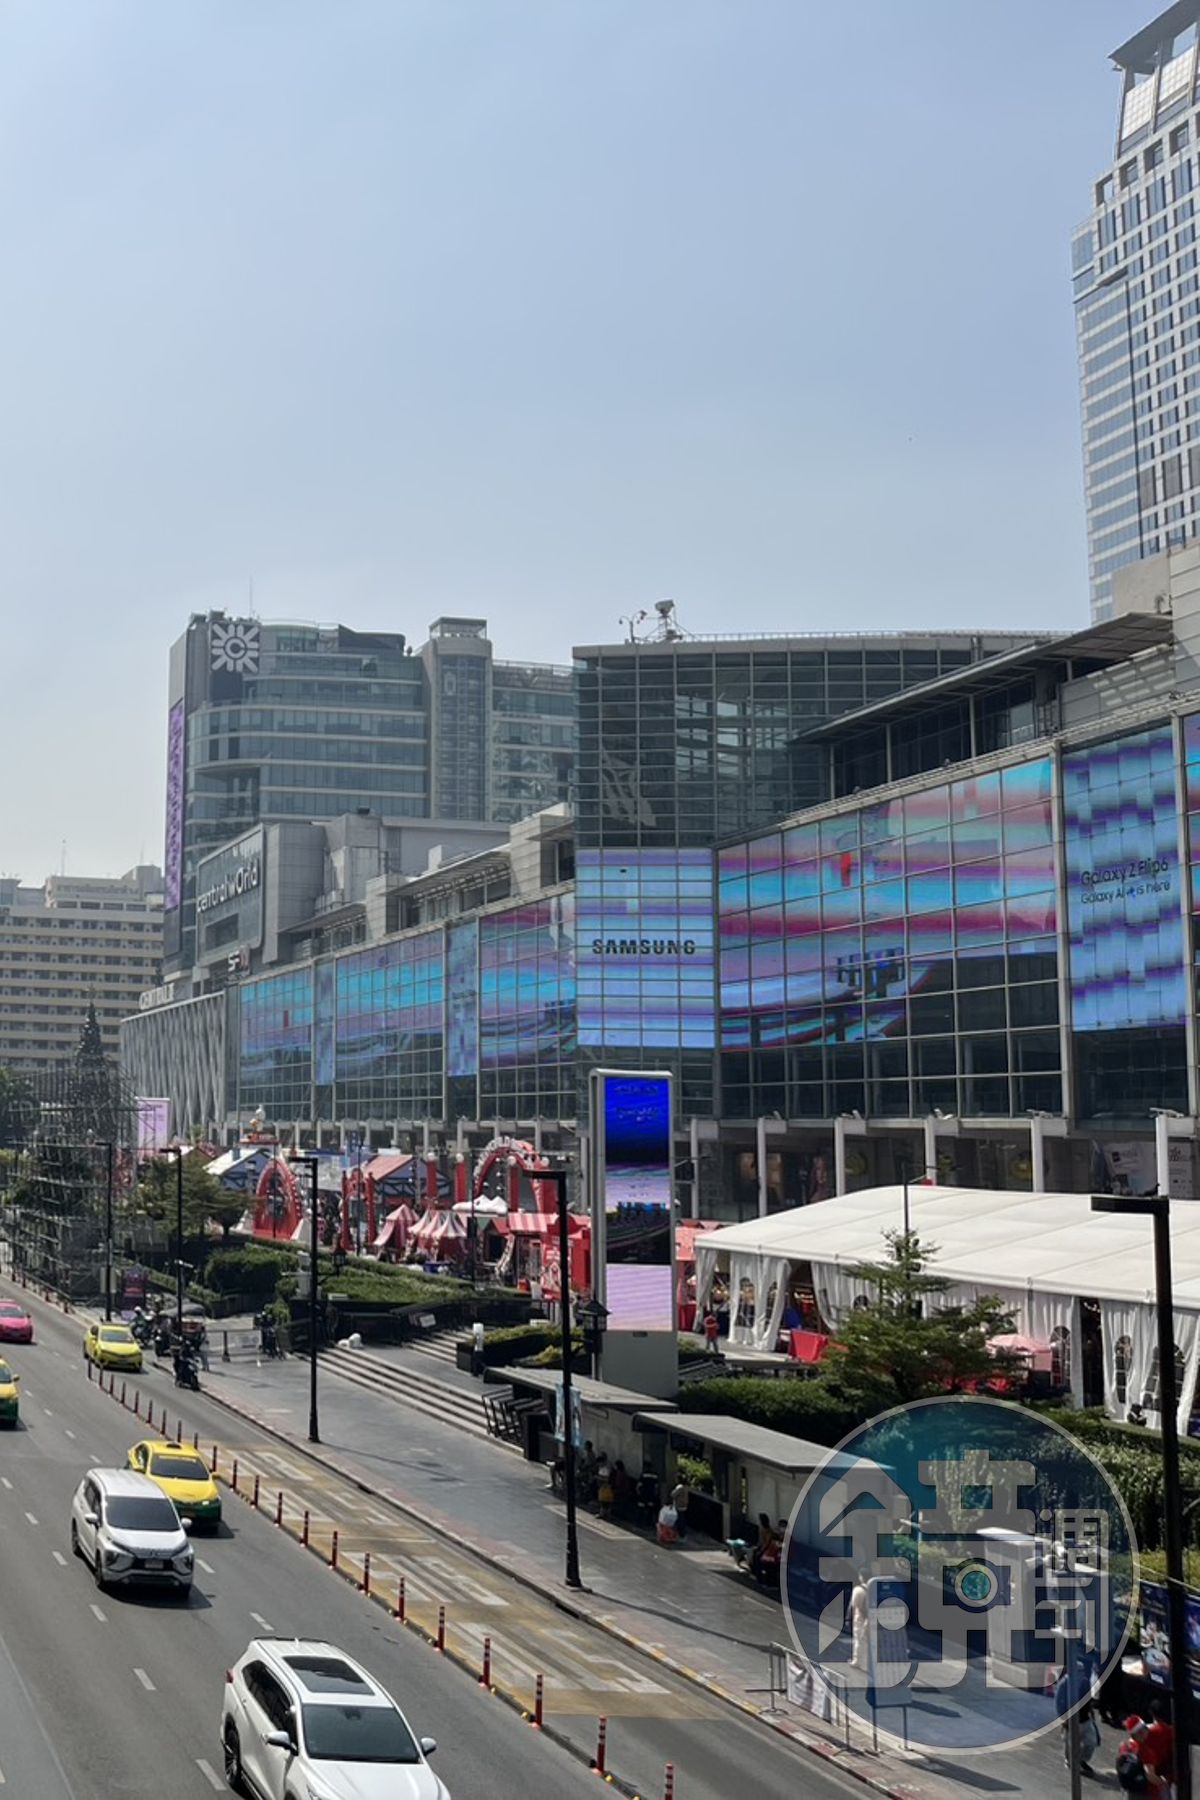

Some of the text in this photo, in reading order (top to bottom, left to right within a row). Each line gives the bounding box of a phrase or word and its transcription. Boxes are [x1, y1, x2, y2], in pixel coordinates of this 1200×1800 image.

[1081, 866, 1125, 885] Galaxy
[1129, 862, 1136, 878] Z
[1081, 890, 1114, 904] Galaxy
[592, 938, 696, 955] SAMSUNG
